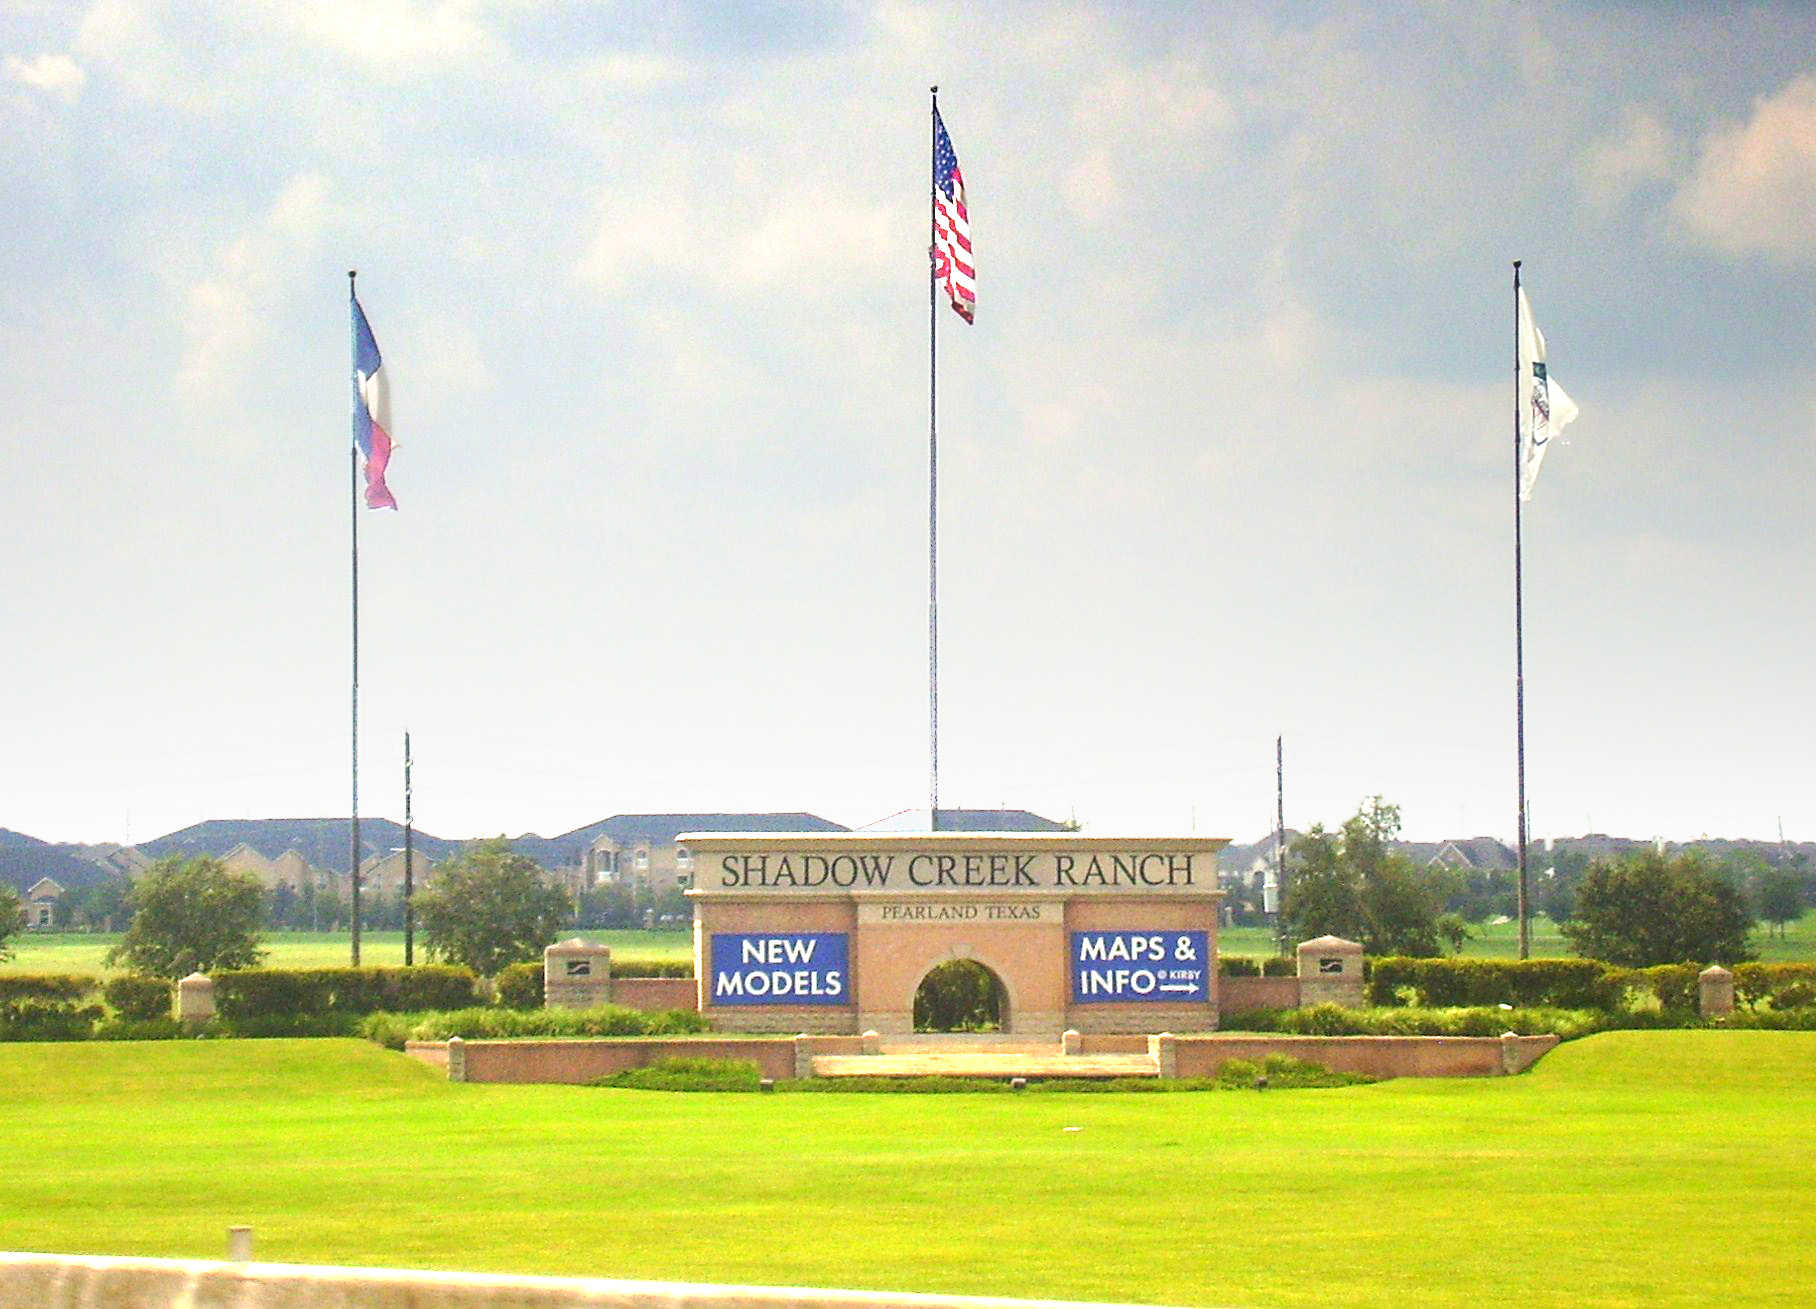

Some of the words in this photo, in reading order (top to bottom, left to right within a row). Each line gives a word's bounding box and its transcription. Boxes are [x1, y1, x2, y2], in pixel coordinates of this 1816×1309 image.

[721, 854, 895, 887] SHADOW
[908, 854, 1040, 886] CREEK
[1055, 853, 1195, 886] RANCH
[882, 905, 979, 921] PEARLAND
[985, 905, 1041, 920] TEXAS
[742, 939, 817, 963] NEW
[1080, 936, 1166, 961] MAPS
[1174, 936, 1197, 960] &
[716, 971, 842, 996] MODELS
[1081, 970, 1156, 994] INFO
[1169, 969, 1201, 980] KIRBY
